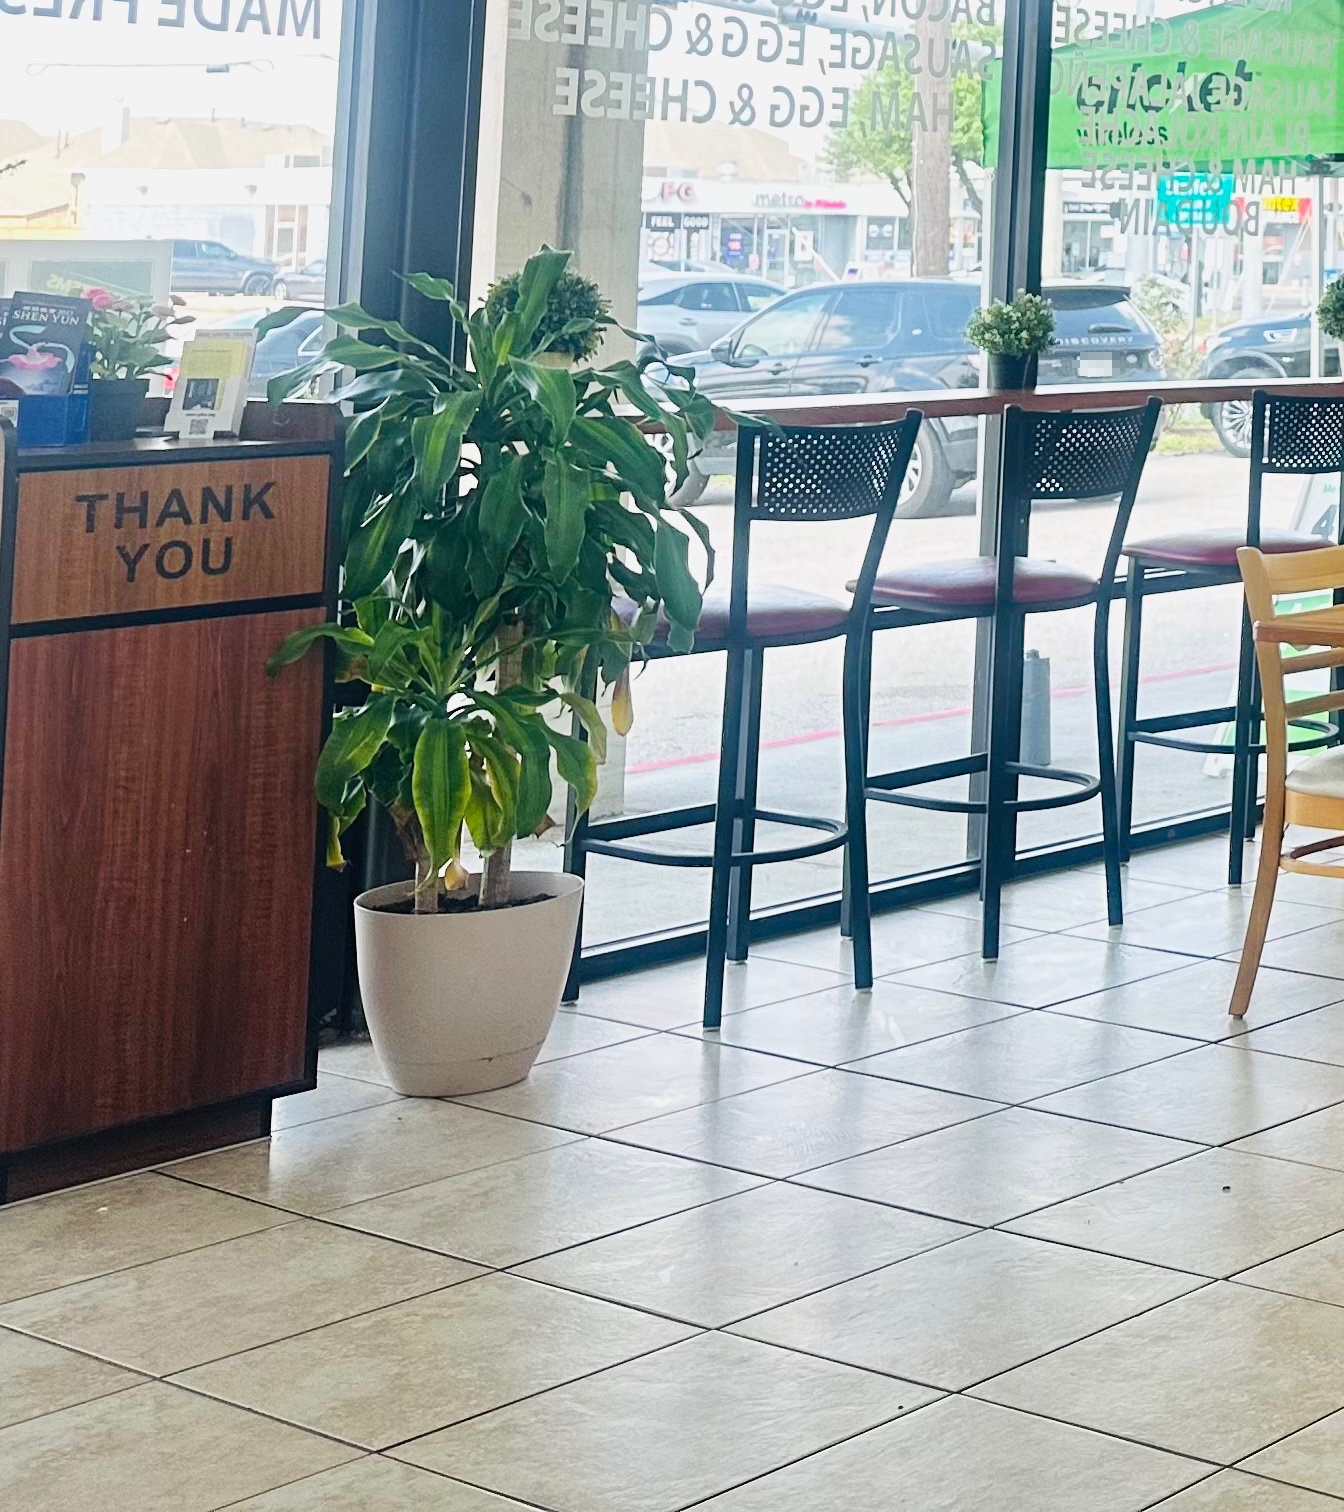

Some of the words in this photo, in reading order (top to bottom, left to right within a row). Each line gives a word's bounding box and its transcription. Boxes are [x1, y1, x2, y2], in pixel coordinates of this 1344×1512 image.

[1077, 59, 1253, 115] cricket
[12, 309, 49, 322] SHEN
[53, 313, 80, 326] YUN
[1055, 335, 1134, 345] DISCOVERY
[74, 481, 278, 533] THANK
[116, 536, 235, 583] YOU
